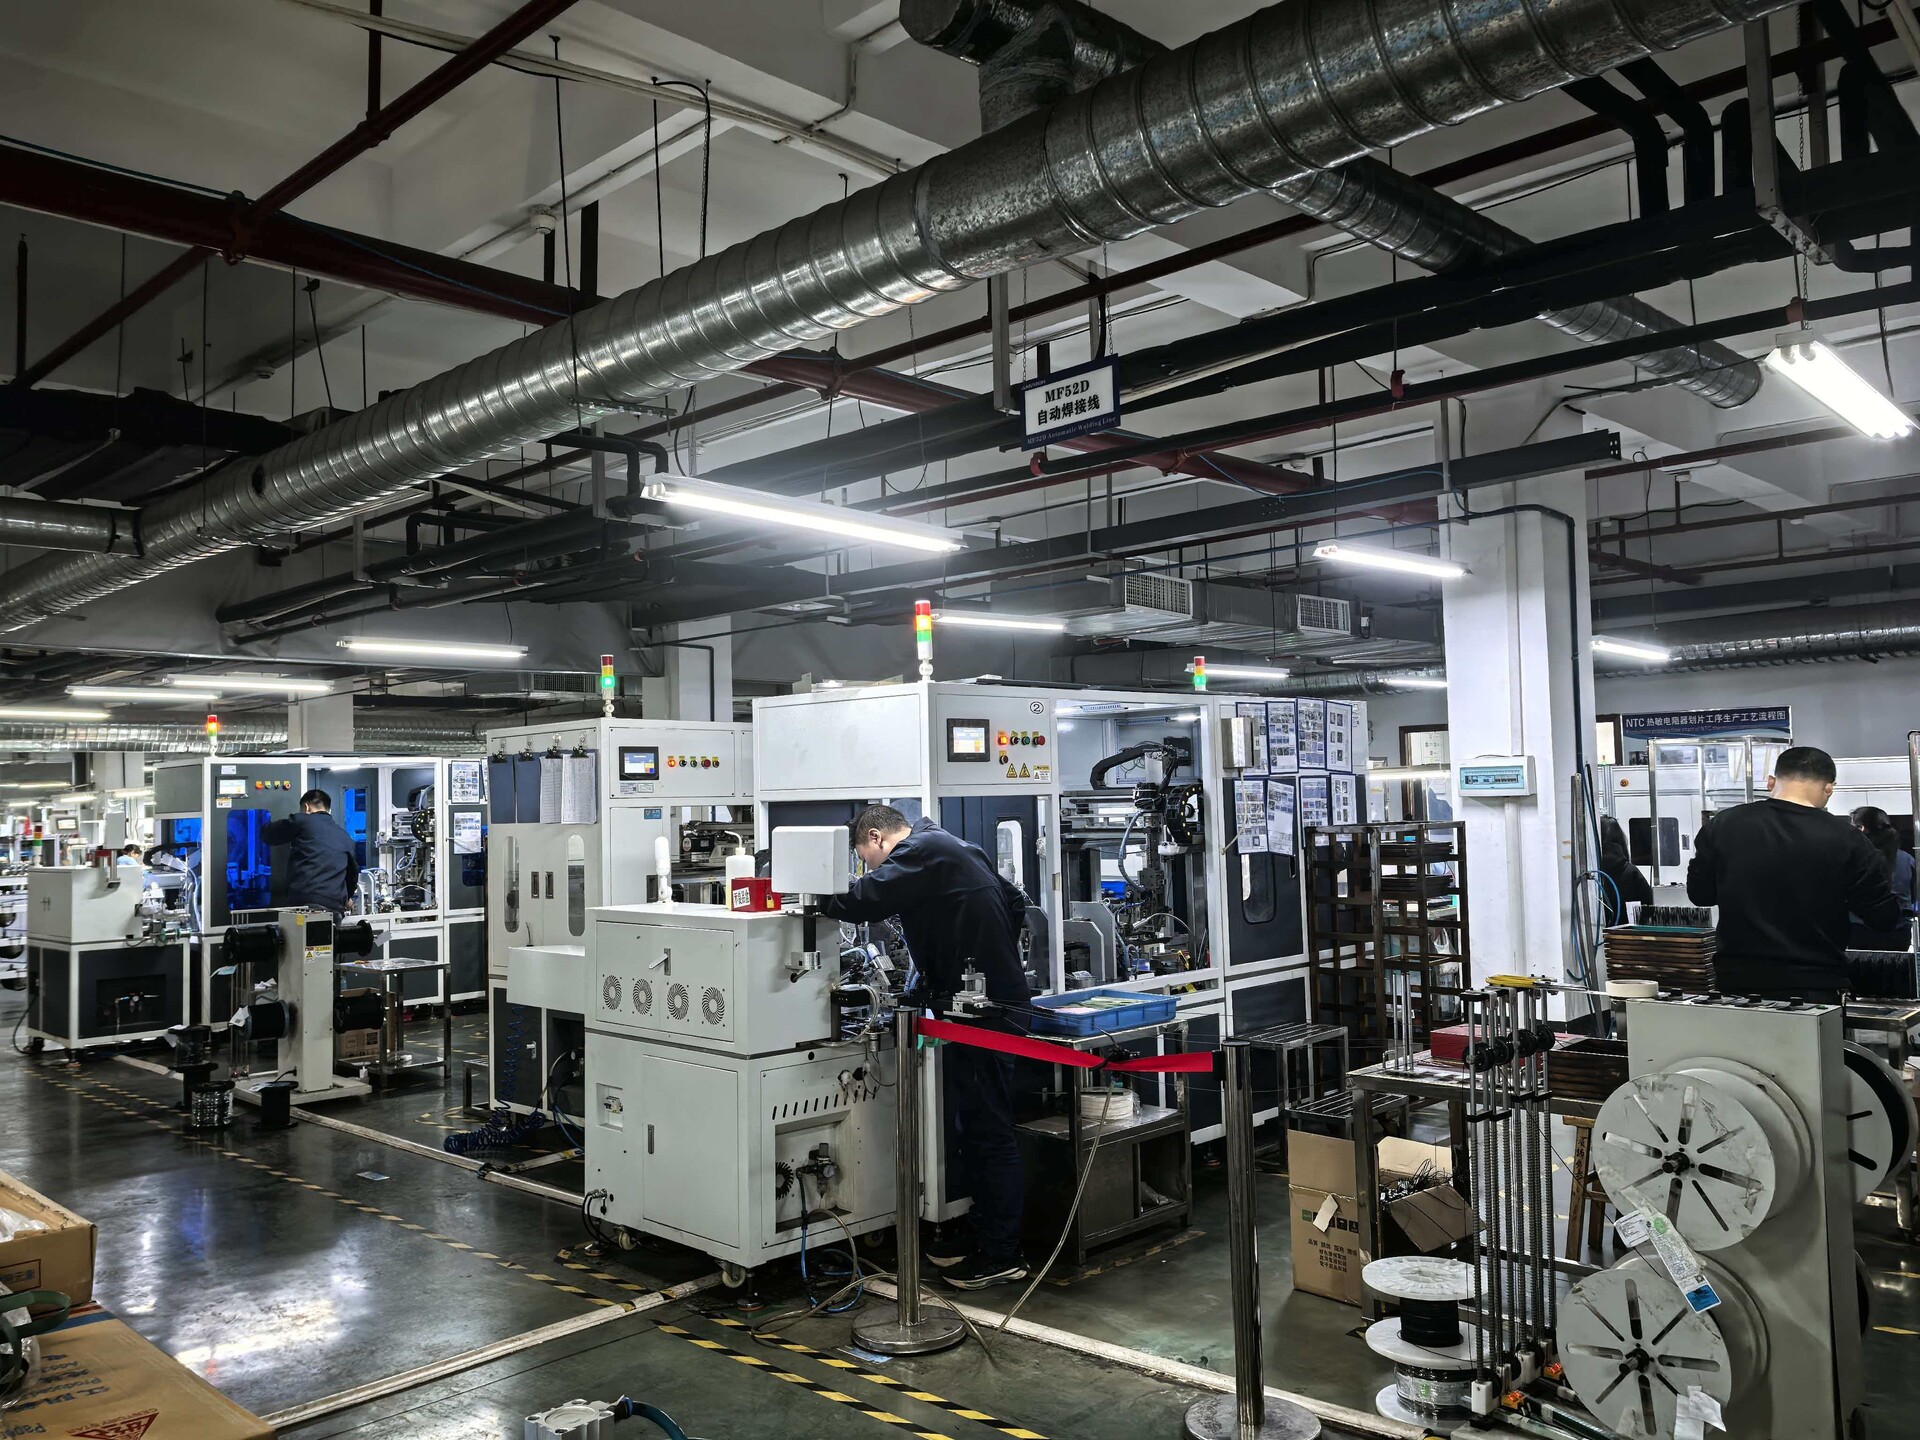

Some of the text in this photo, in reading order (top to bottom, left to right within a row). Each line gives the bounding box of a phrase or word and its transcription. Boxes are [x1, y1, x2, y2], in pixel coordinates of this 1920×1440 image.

[1044, 380, 1090, 404] MF52D
[1037, 394, 1100, 426] 自动焊接线
[1047, 427, 1077, 439] Automatic
[1077, 420, 1102, 431] Welding
[1102, 416, 1117, 425] Line
[1625, 710, 1786, 728] NTC 热敏电阻器划片工序生产工艺流程图
